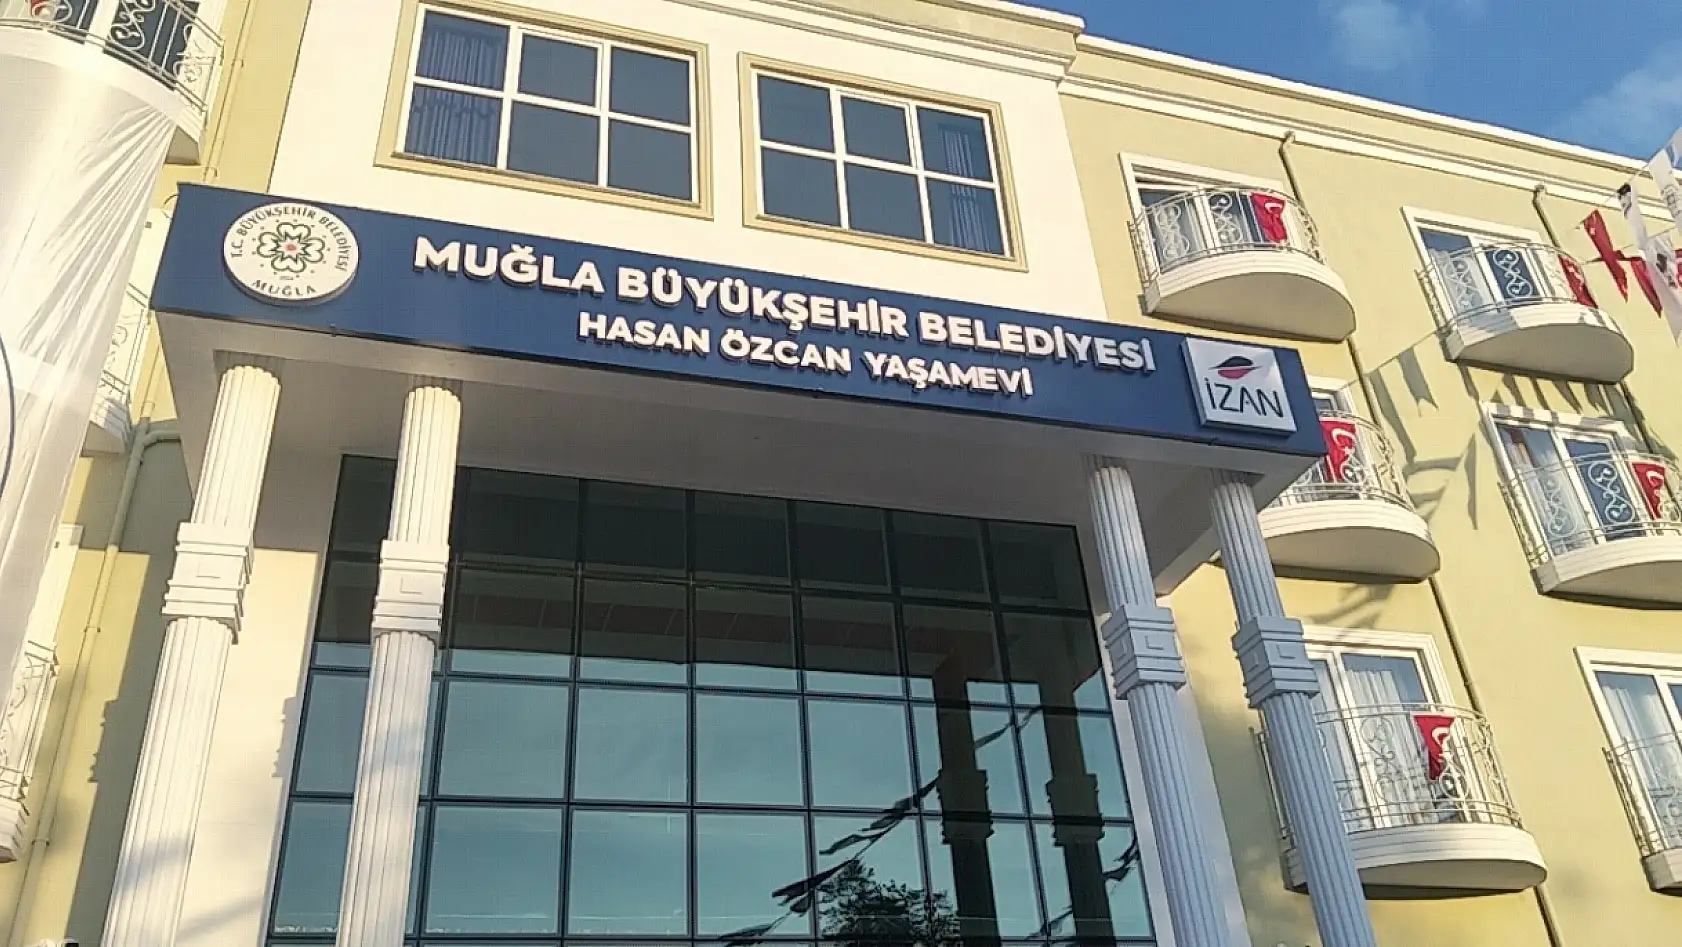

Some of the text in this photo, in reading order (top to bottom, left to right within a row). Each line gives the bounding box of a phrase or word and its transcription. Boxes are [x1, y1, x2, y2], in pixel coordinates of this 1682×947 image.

[231, 206, 352, 272] T.C. BÜYÜKŞEHİR BELEDİYESİ
[252, 279, 317, 297] MUĞLA
[414, 236, 1156, 372] MUĞLA BÜYÜKŞEHİR BELEDİYESİ
[578, 311, 1034, 397] HASAN ÖZCAN YAŞAMEVİ
[1204, 377, 1284, 418] İZAN
